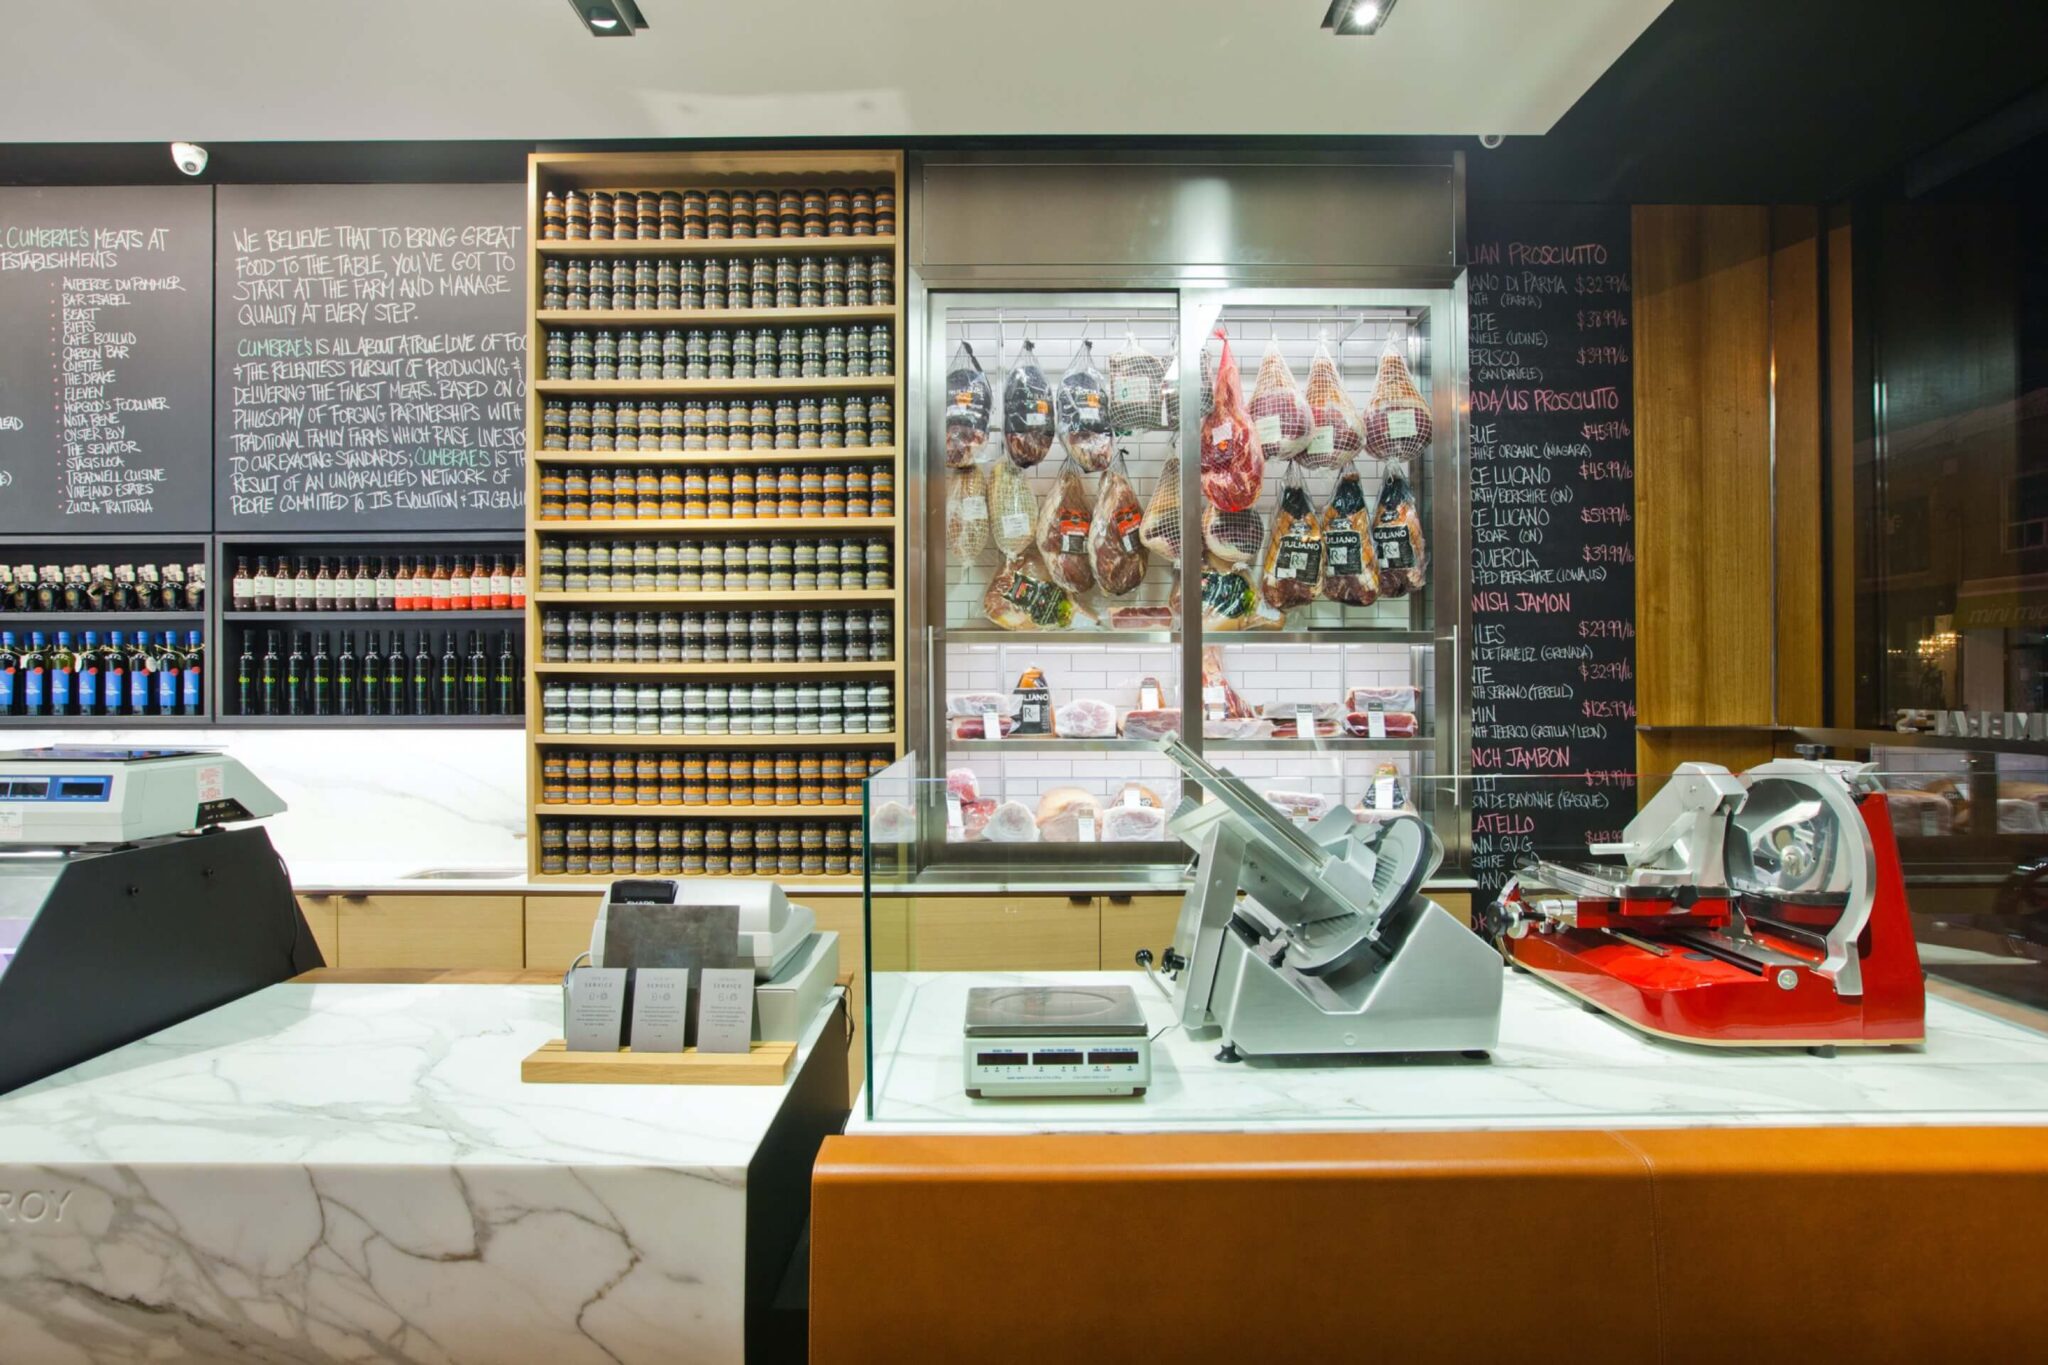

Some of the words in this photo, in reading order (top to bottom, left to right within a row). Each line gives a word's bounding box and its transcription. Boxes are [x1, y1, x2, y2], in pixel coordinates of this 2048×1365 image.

[94, 228, 144, 250] MEATS
[147, 228, 170, 251] AT
[233, 227, 261, 252] WE
[264, 227, 333, 252] BELIEVE
[334, 225, 377, 250] THAT
[378, 227, 402, 249] TO
[404, 227, 458, 248] BRING
[461, 226, 522, 249] GREAT
[1, 250, 118, 272] ESTABLISHMENTS
[235, 256, 276, 278] FOOD
[277, 255, 299, 276] TO
[299, 254, 335, 275] THE
[332, 253, 388, 279] TABLE,
[392, 251, 446, 277] YOU'VE
[451, 251, 486, 271] GOT
[487, 251, 516, 272] TO
[1508, 242, 1607, 265] PROSCIUTTO
[115, 278, 131, 291] DU
[232, 279, 292, 300] START
[294, 277, 318, 300] AT
[318, 276, 349, 299] THE
[351, 278, 395, 300] FARM
[400, 274, 434, 298] AND
[440, 272, 512, 296] MANAGE
[1506, 274, 1519, 291] DI
[1522, 271, 1568, 294] PARMA
[61, 293, 87, 307] BAR
[62, 307, 101, 321] BEAST
[238, 303, 297, 326] QUALITY
[301, 302, 322, 324] AT
[325, 302, 369, 325] EVERY
[374, 302, 419, 324] STEP.
[62, 333, 91, 346] CAFE
[315, 338, 330, 355] IS
[332, 337, 357, 356] ALL
[356, 335, 402, 357] ABOUT
[445, 333, 475, 354] LOVE
[481, 333, 503, 353] OF
[104, 344, 130, 359] BAR
[62, 372, 81, 386] THE
[81, 369, 117, 385] DRAKE
[242, 362, 270, 386] THE
[271, 360, 346, 382] RELENTLESS
[350, 358, 404, 378] PURSUIT
[405, 358, 423, 379] OF
[425, 357, 510, 379] PRODUCING
[64, 385, 104, 401] ELEVEN
[233, 384, 306, 406] DELIVERING
[306, 381, 336, 401] THE
[337, 380, 387, 401] FINEST
[390, 381, 437, 400] MEATS.
[437, 379, 488, 400] BASED
[494, 378, 513, 397] ON
[1534, 387, 1619, 413] PROSCIUTTO
[232, 404, 304, 430] PHILOSOPHY
[308, 404, 328, 423] OF
[328, 404, 387, 425] FORGING
[389, 402, 481, 424] PARTNERSHIPS
[488, 401, 523, 421] WITH
[63, 426, 102, 442] OYSTER
[104, 425, 126, 440] BOY
[229, 430, 305, 453] TRADITIONAL
[304, 426, 344, 448] FAMILY
[347, 426, 389, 447] FARMS
[391, 424, 431, 445] WHICH
[432, 425, 474, 448] RAISE
[63, 441, 86, 457] THE
[87, 440, 142, 455] SENATOR
[1498, 443, 1542, 460] ORGANIC
[1543, 442, 1592, 460] (NIAGARA)
[229, 456, 249, 473] TO
[251, 453, 278, 472] OUR
[279, 450, 334, 473] EXACTING
[495, 450, 507, 467] IS
[229, 471, 281, 495] RESULT
[283, 473, 302, 492] OF
[305, 472, 324, 493] AN
[421, 468, 488, 488] NETWORK
[493, 468, 512, 484] OF
[1493, 463, 1550, 486] LUCANO
[65, 499, 100, 515] ZUCCA
[229, 495, 275, 516] PEOPLE
[279, 492, 349, 512] COMMITTED
[350, 492, 364, 512] TO
[367, 491, 393, 509] ITS
[393, 489, 459, 510] EVOLUTION
[1550, 485, 1573, 506] (ON)
[1494, 507, 1550, 527] LUCANO
[1476, 528, 1510, 542] BOAR
[1518, 528, 1543, 544] (ON)
[1471, 548, 1540, 571] QUERCIA
[1514, 591, 1571, 613] JAMON
[1505, 746, 1570, 769] JAMBON
[1509, 790, 1554, 810] BAYONNE
[1558, 790, 1610, 810] (BASQUE)
